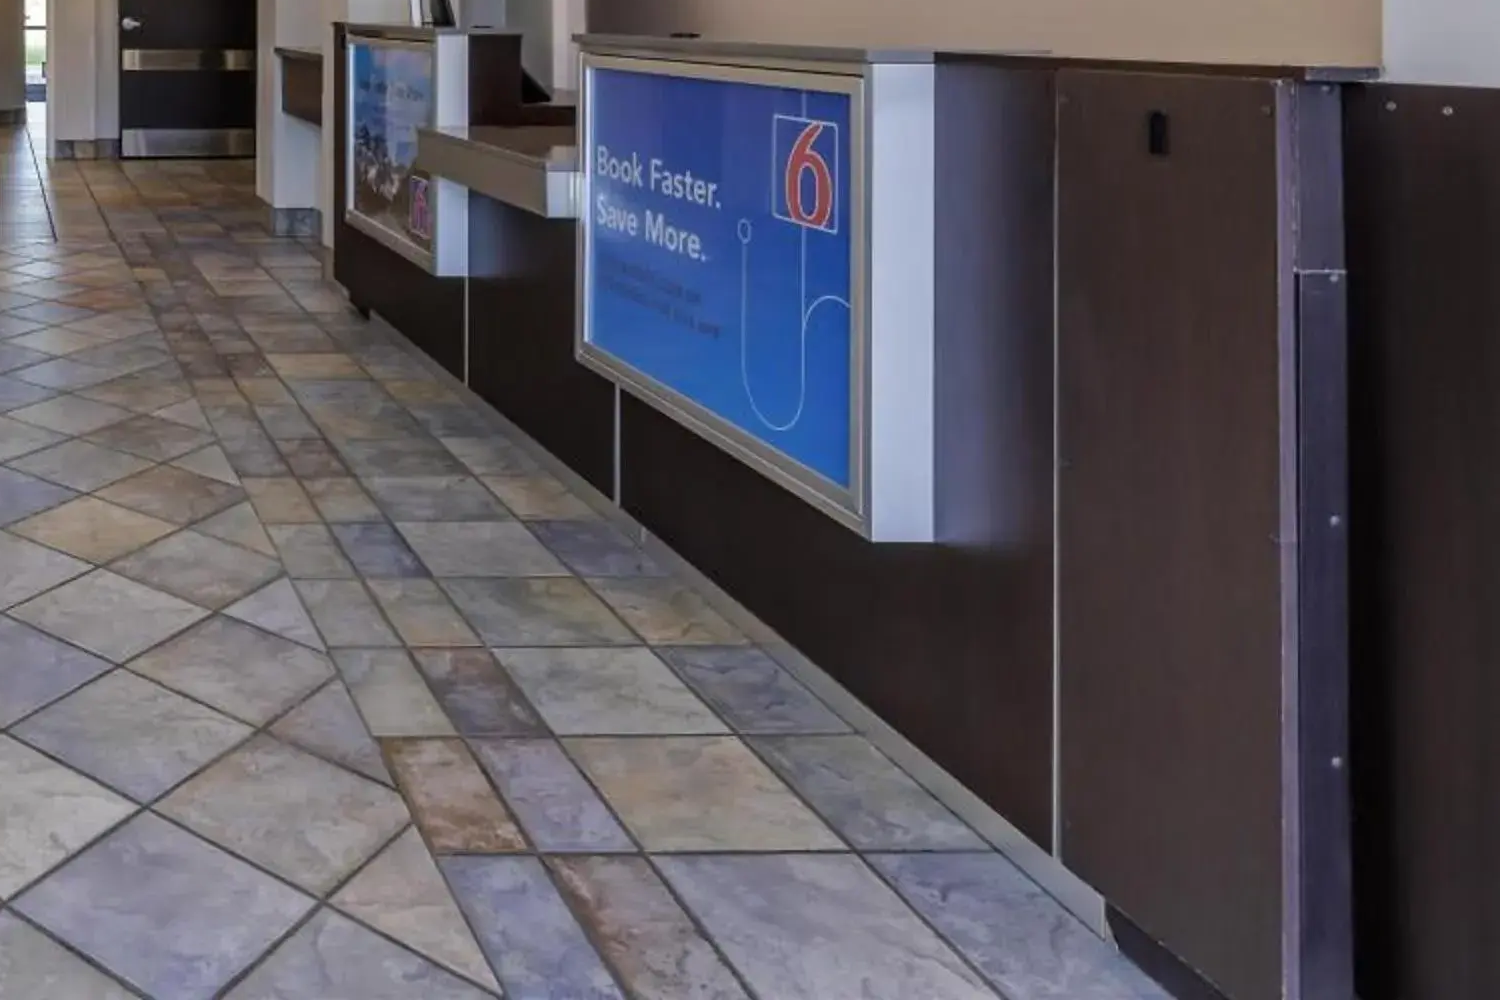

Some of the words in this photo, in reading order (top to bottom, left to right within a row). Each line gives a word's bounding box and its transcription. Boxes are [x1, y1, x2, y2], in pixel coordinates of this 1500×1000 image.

[597, 144, 643, 188] Book
[650, 158, 722, 210] Faster.
[785, 121, 832, 229] 6
[597, 193, 638, 236] Save
[645, 209, 707, 262] More.
